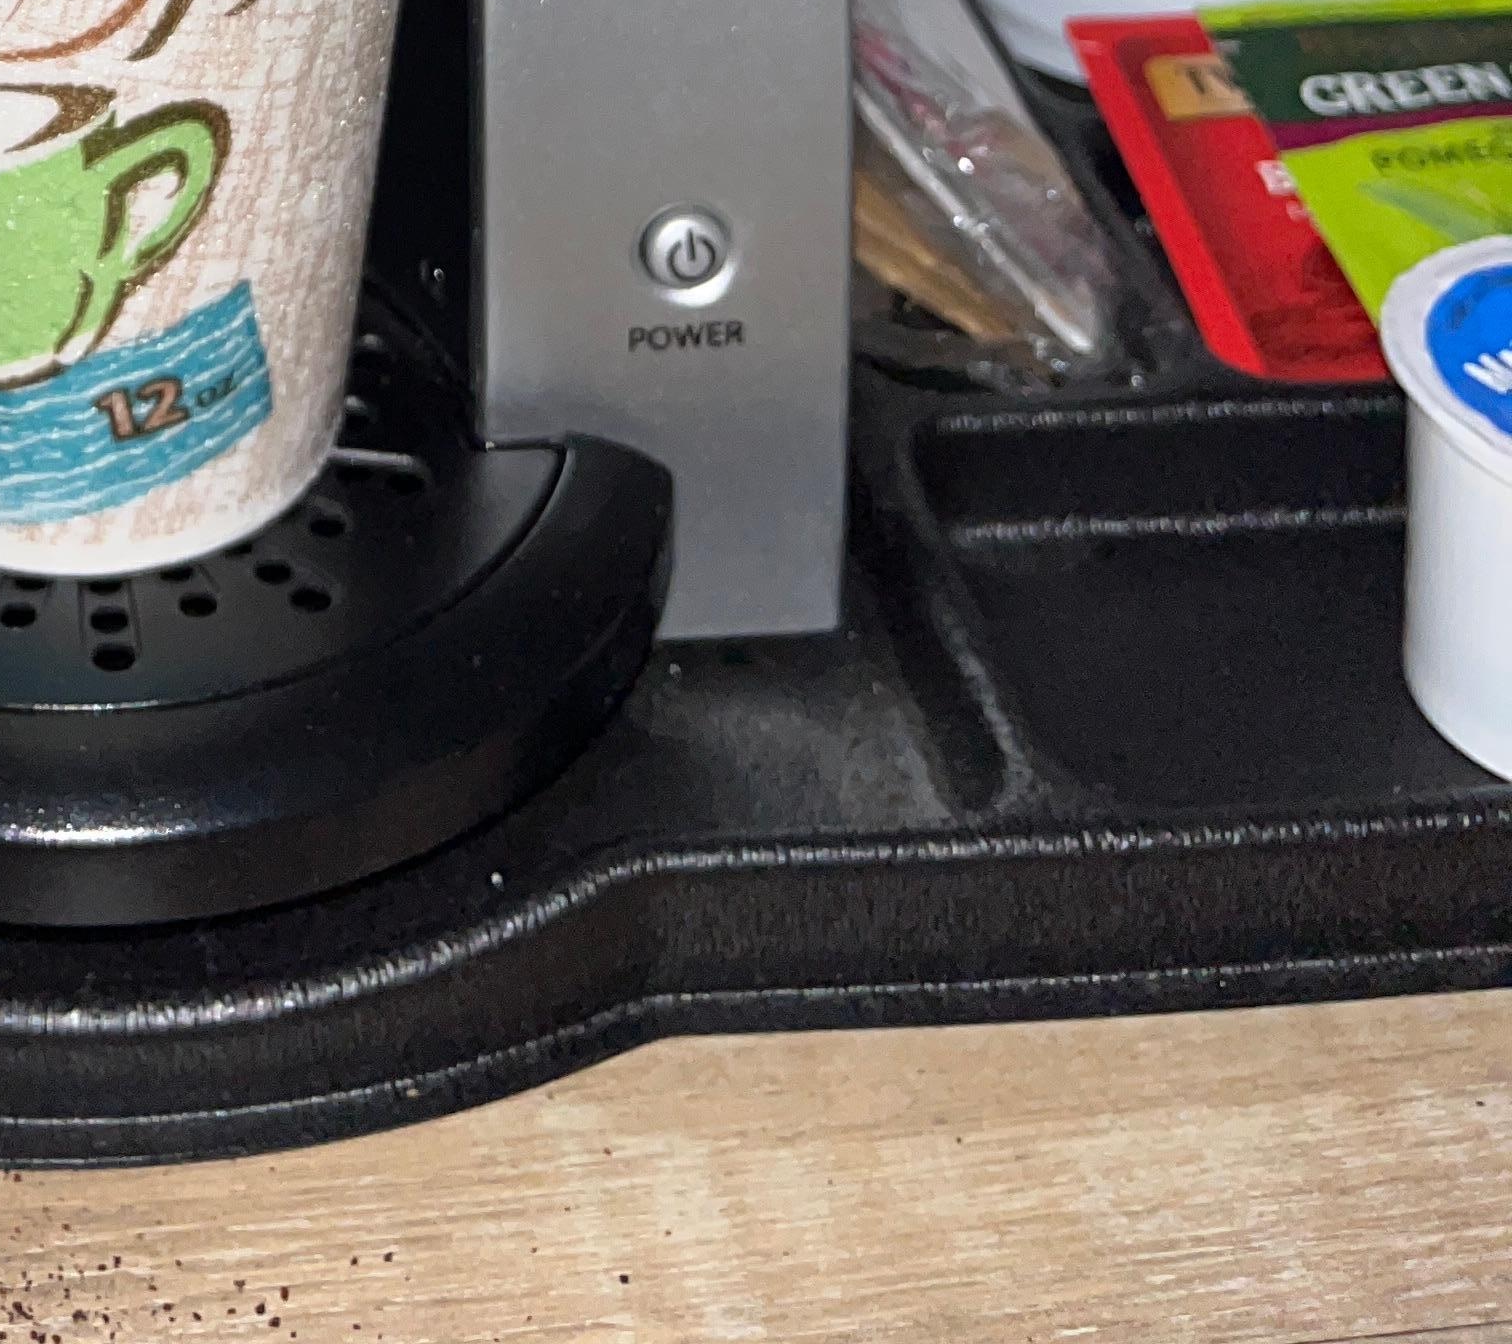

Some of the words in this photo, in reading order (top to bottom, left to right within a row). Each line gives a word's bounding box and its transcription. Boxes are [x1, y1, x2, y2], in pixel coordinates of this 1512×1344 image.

[1299, 60, 1512, 116] GREEN
[628, 320, 744, 353] POWER
[91, 374, 191, 444] 12
